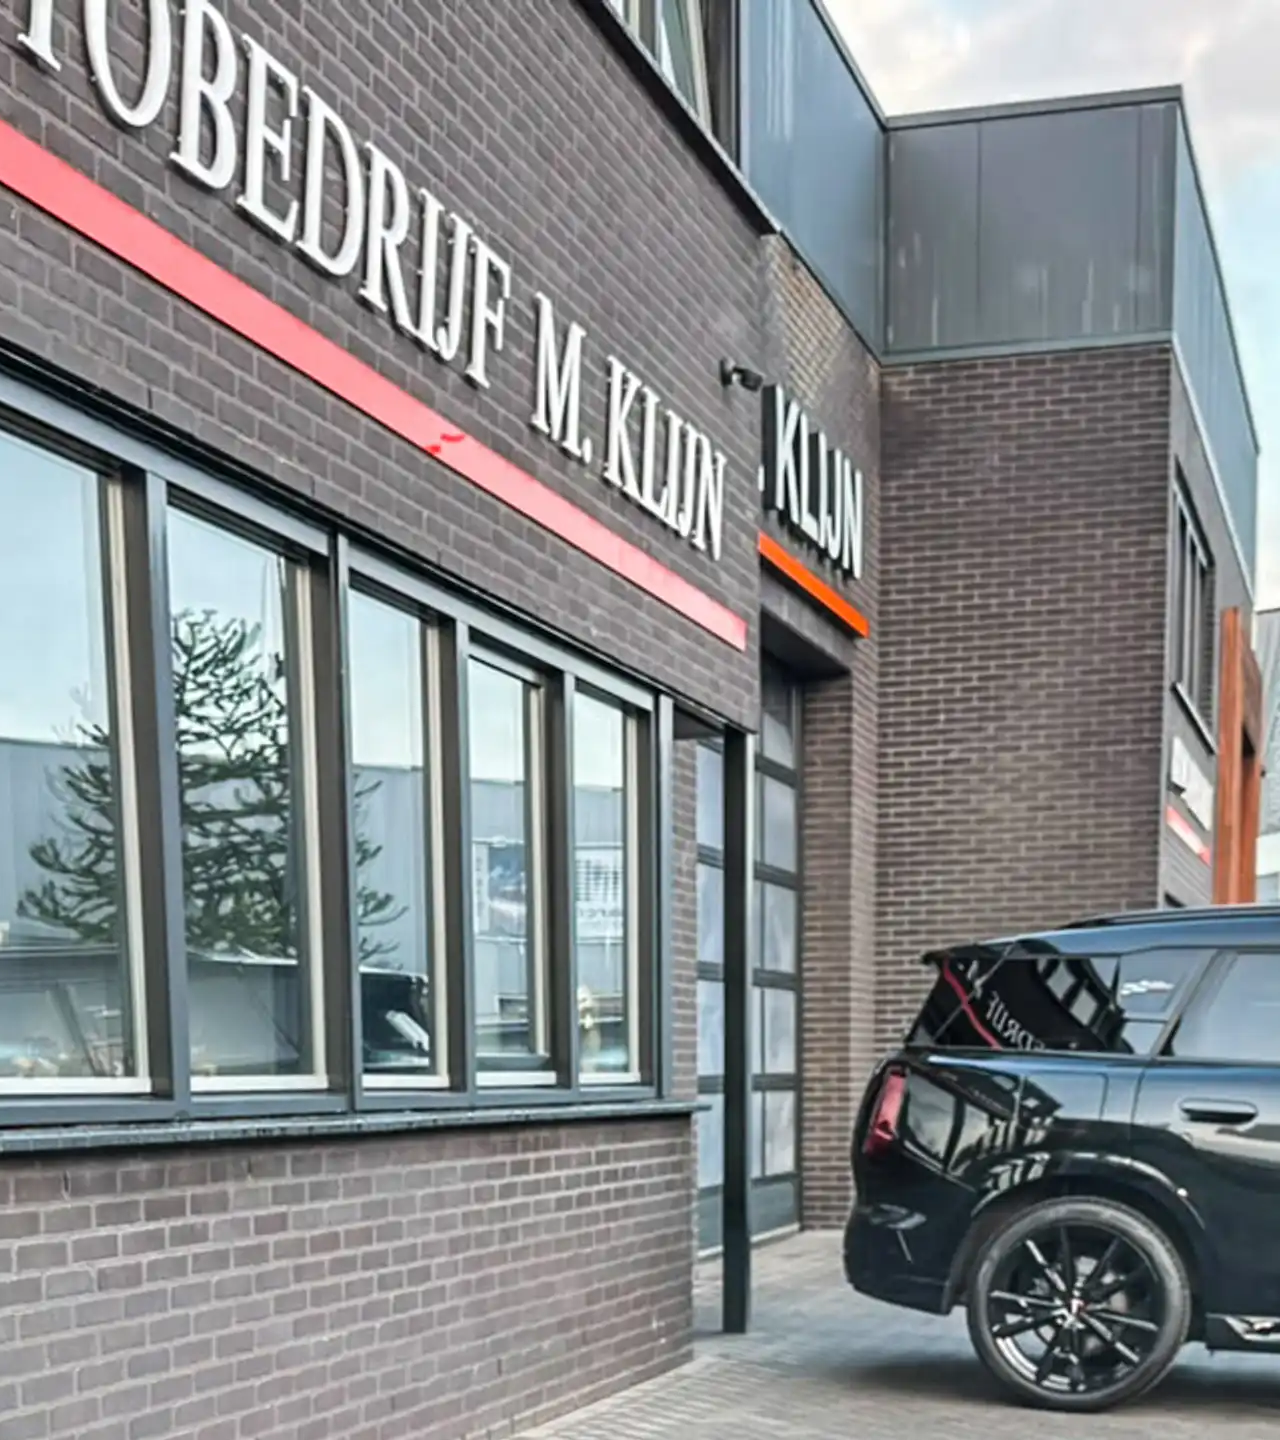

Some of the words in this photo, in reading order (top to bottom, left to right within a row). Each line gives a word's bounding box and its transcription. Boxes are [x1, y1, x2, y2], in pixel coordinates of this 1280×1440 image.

[530, 291, 592, 463] M.
[603, 355, 727, 561] KLIJN
[773, 383, 863, 580] KLIJN
